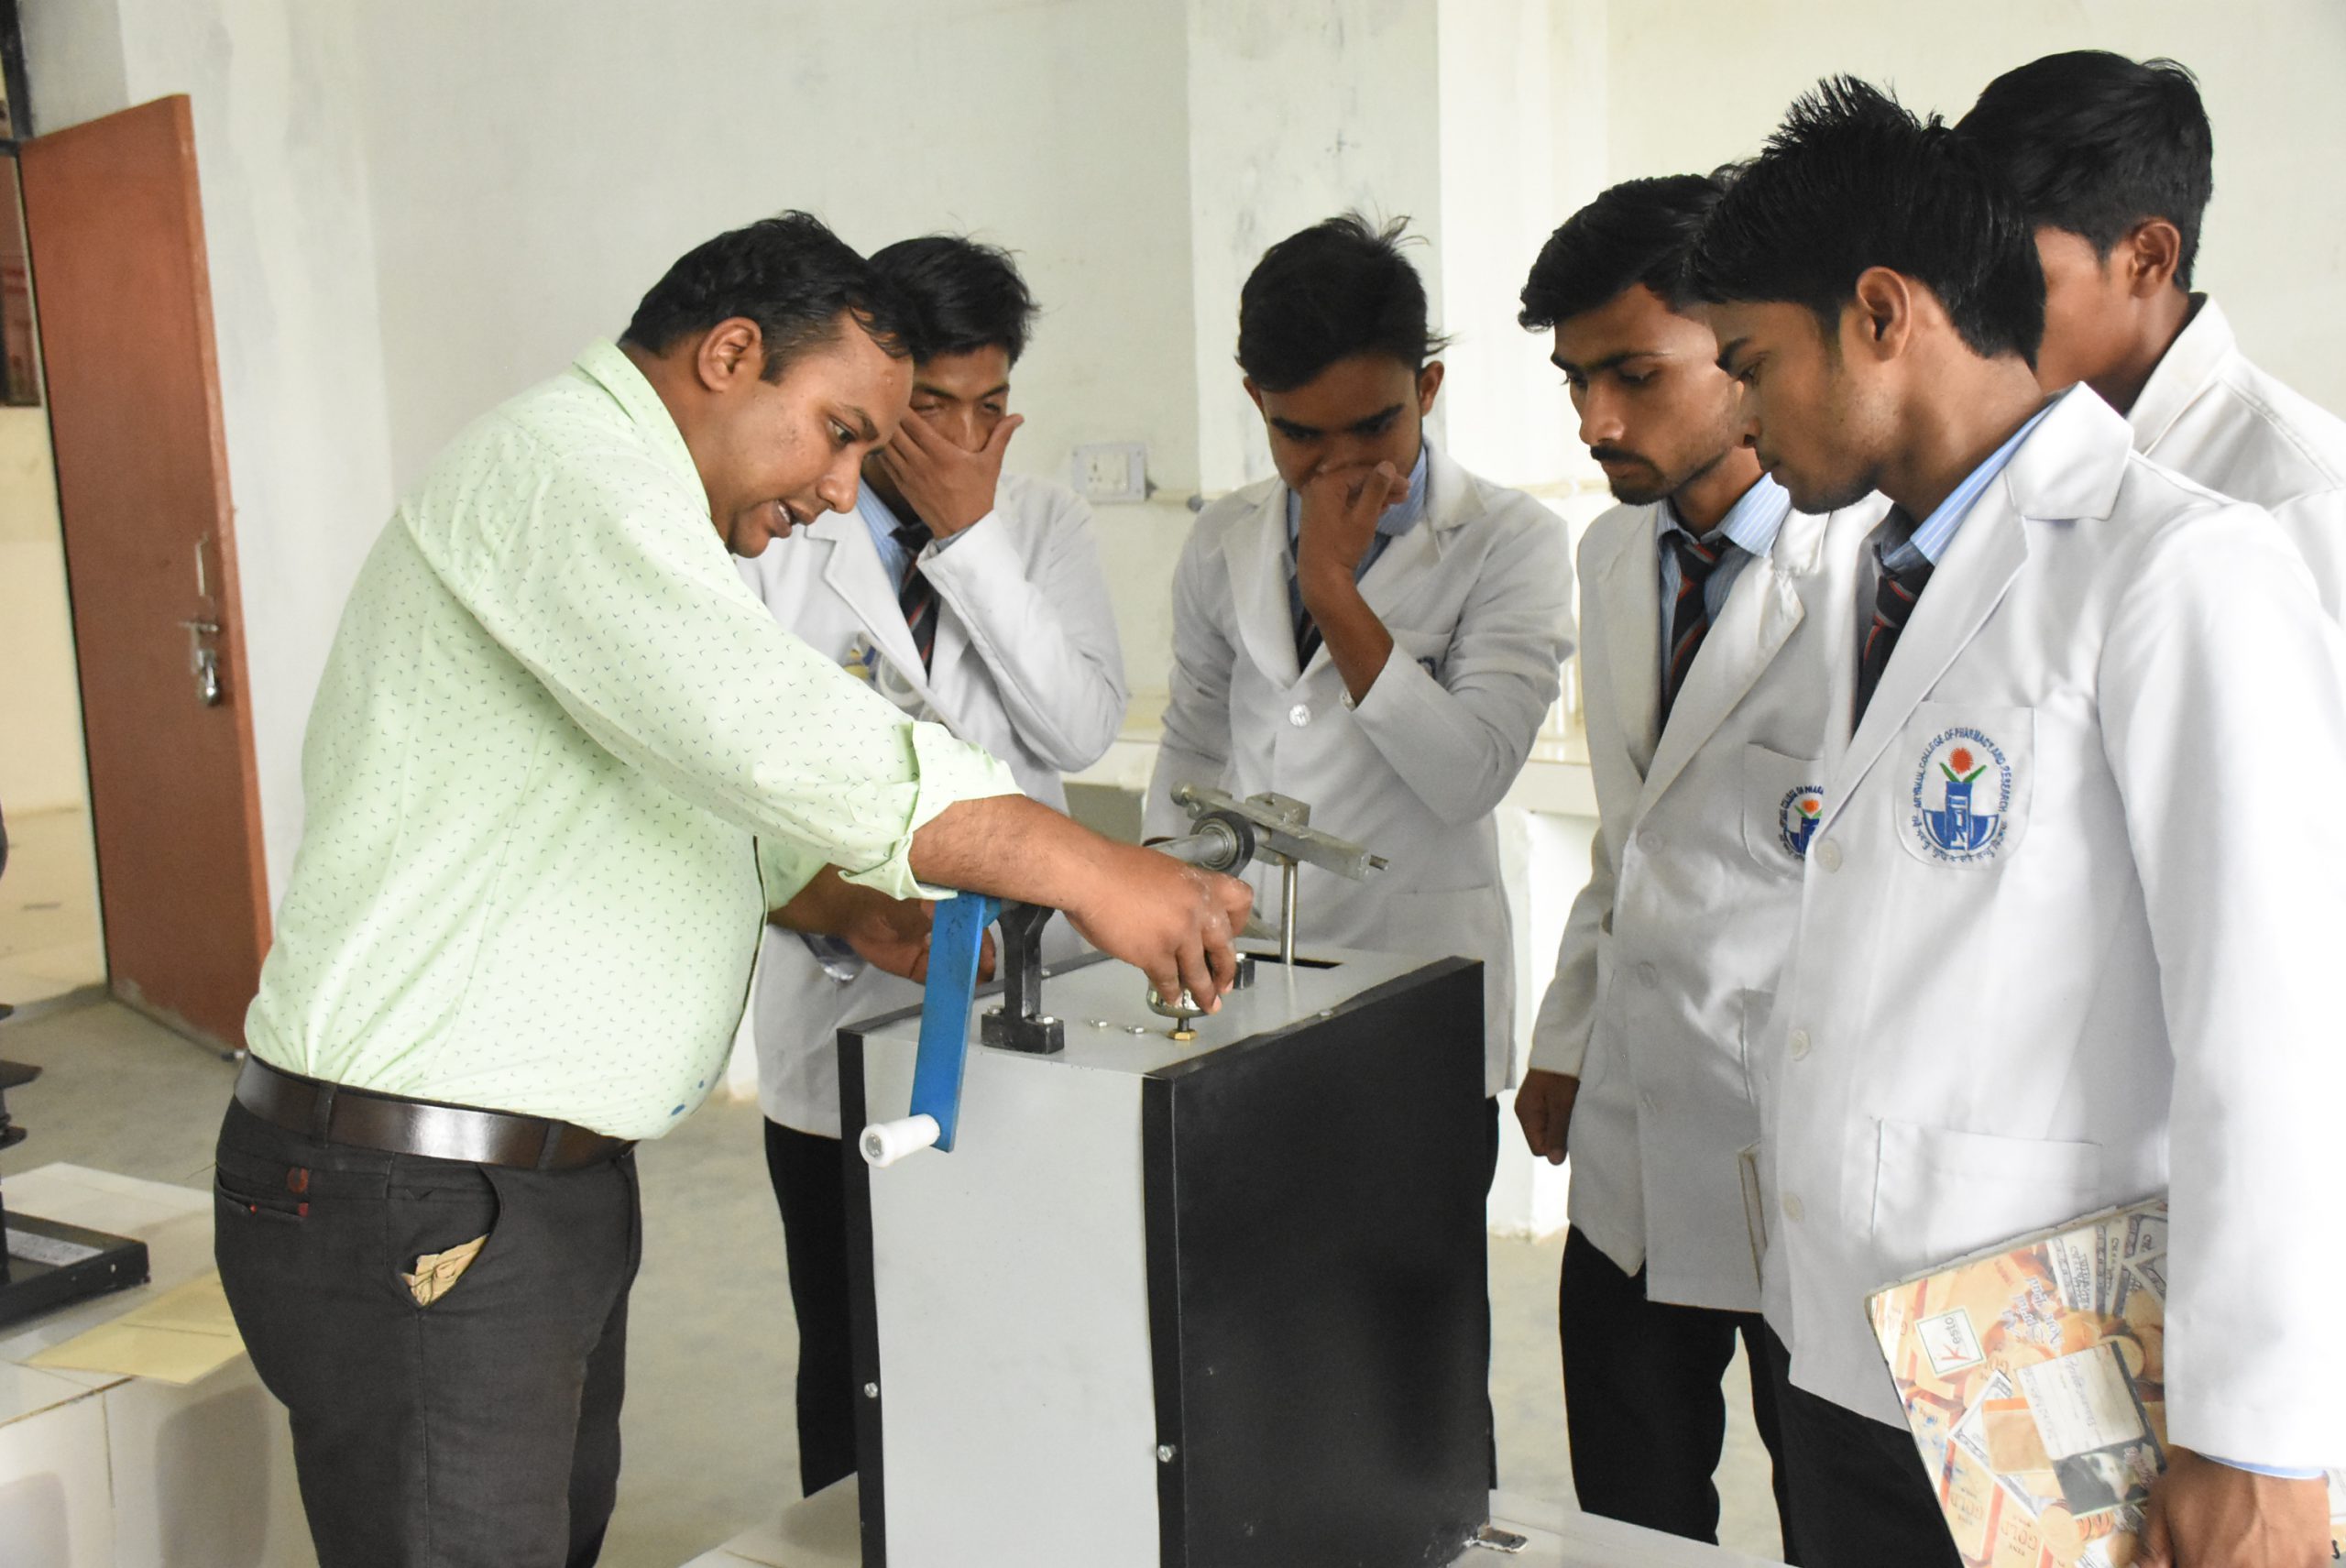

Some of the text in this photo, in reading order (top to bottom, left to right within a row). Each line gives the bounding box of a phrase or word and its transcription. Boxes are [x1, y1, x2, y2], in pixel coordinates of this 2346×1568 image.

[1919, 734, 1944, 769] COLLEGE
[1945, 729, 1955, 741] OF
[1955, 728, 1994, 750] PHARMACY
